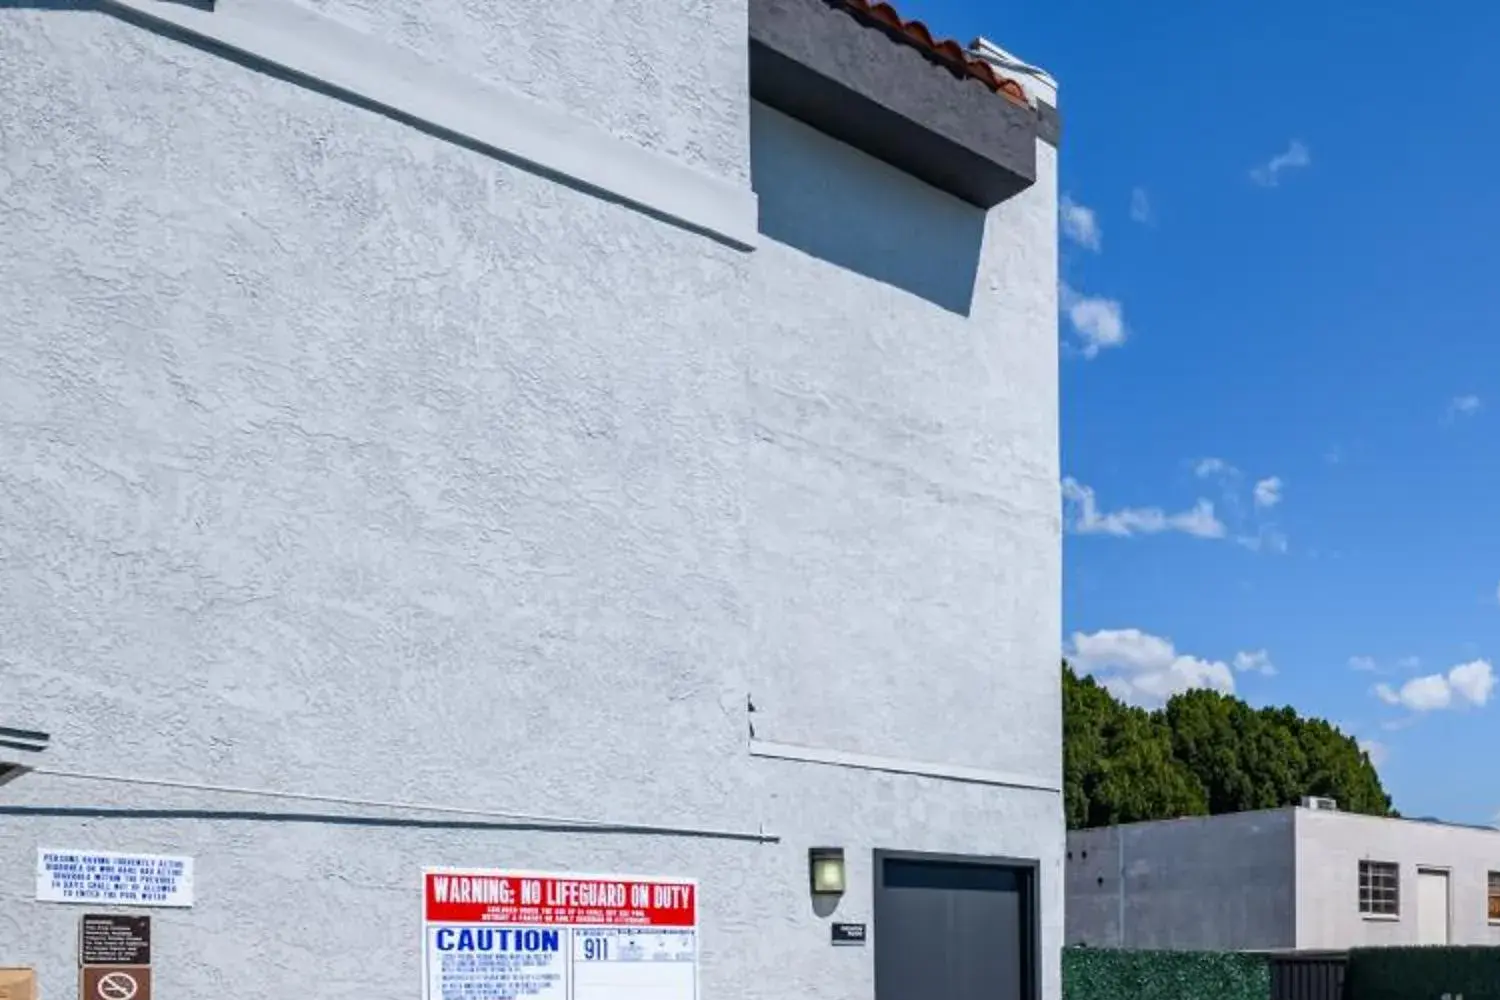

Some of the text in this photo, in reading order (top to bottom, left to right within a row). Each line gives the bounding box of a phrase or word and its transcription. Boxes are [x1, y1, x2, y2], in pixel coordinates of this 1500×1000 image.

[434, 876, 689, 909] WARNING: NO LIFEGUARD ON DUTY
[436, 928, 559, 951] CAUTION
[584, 937, 608, 960] 911
